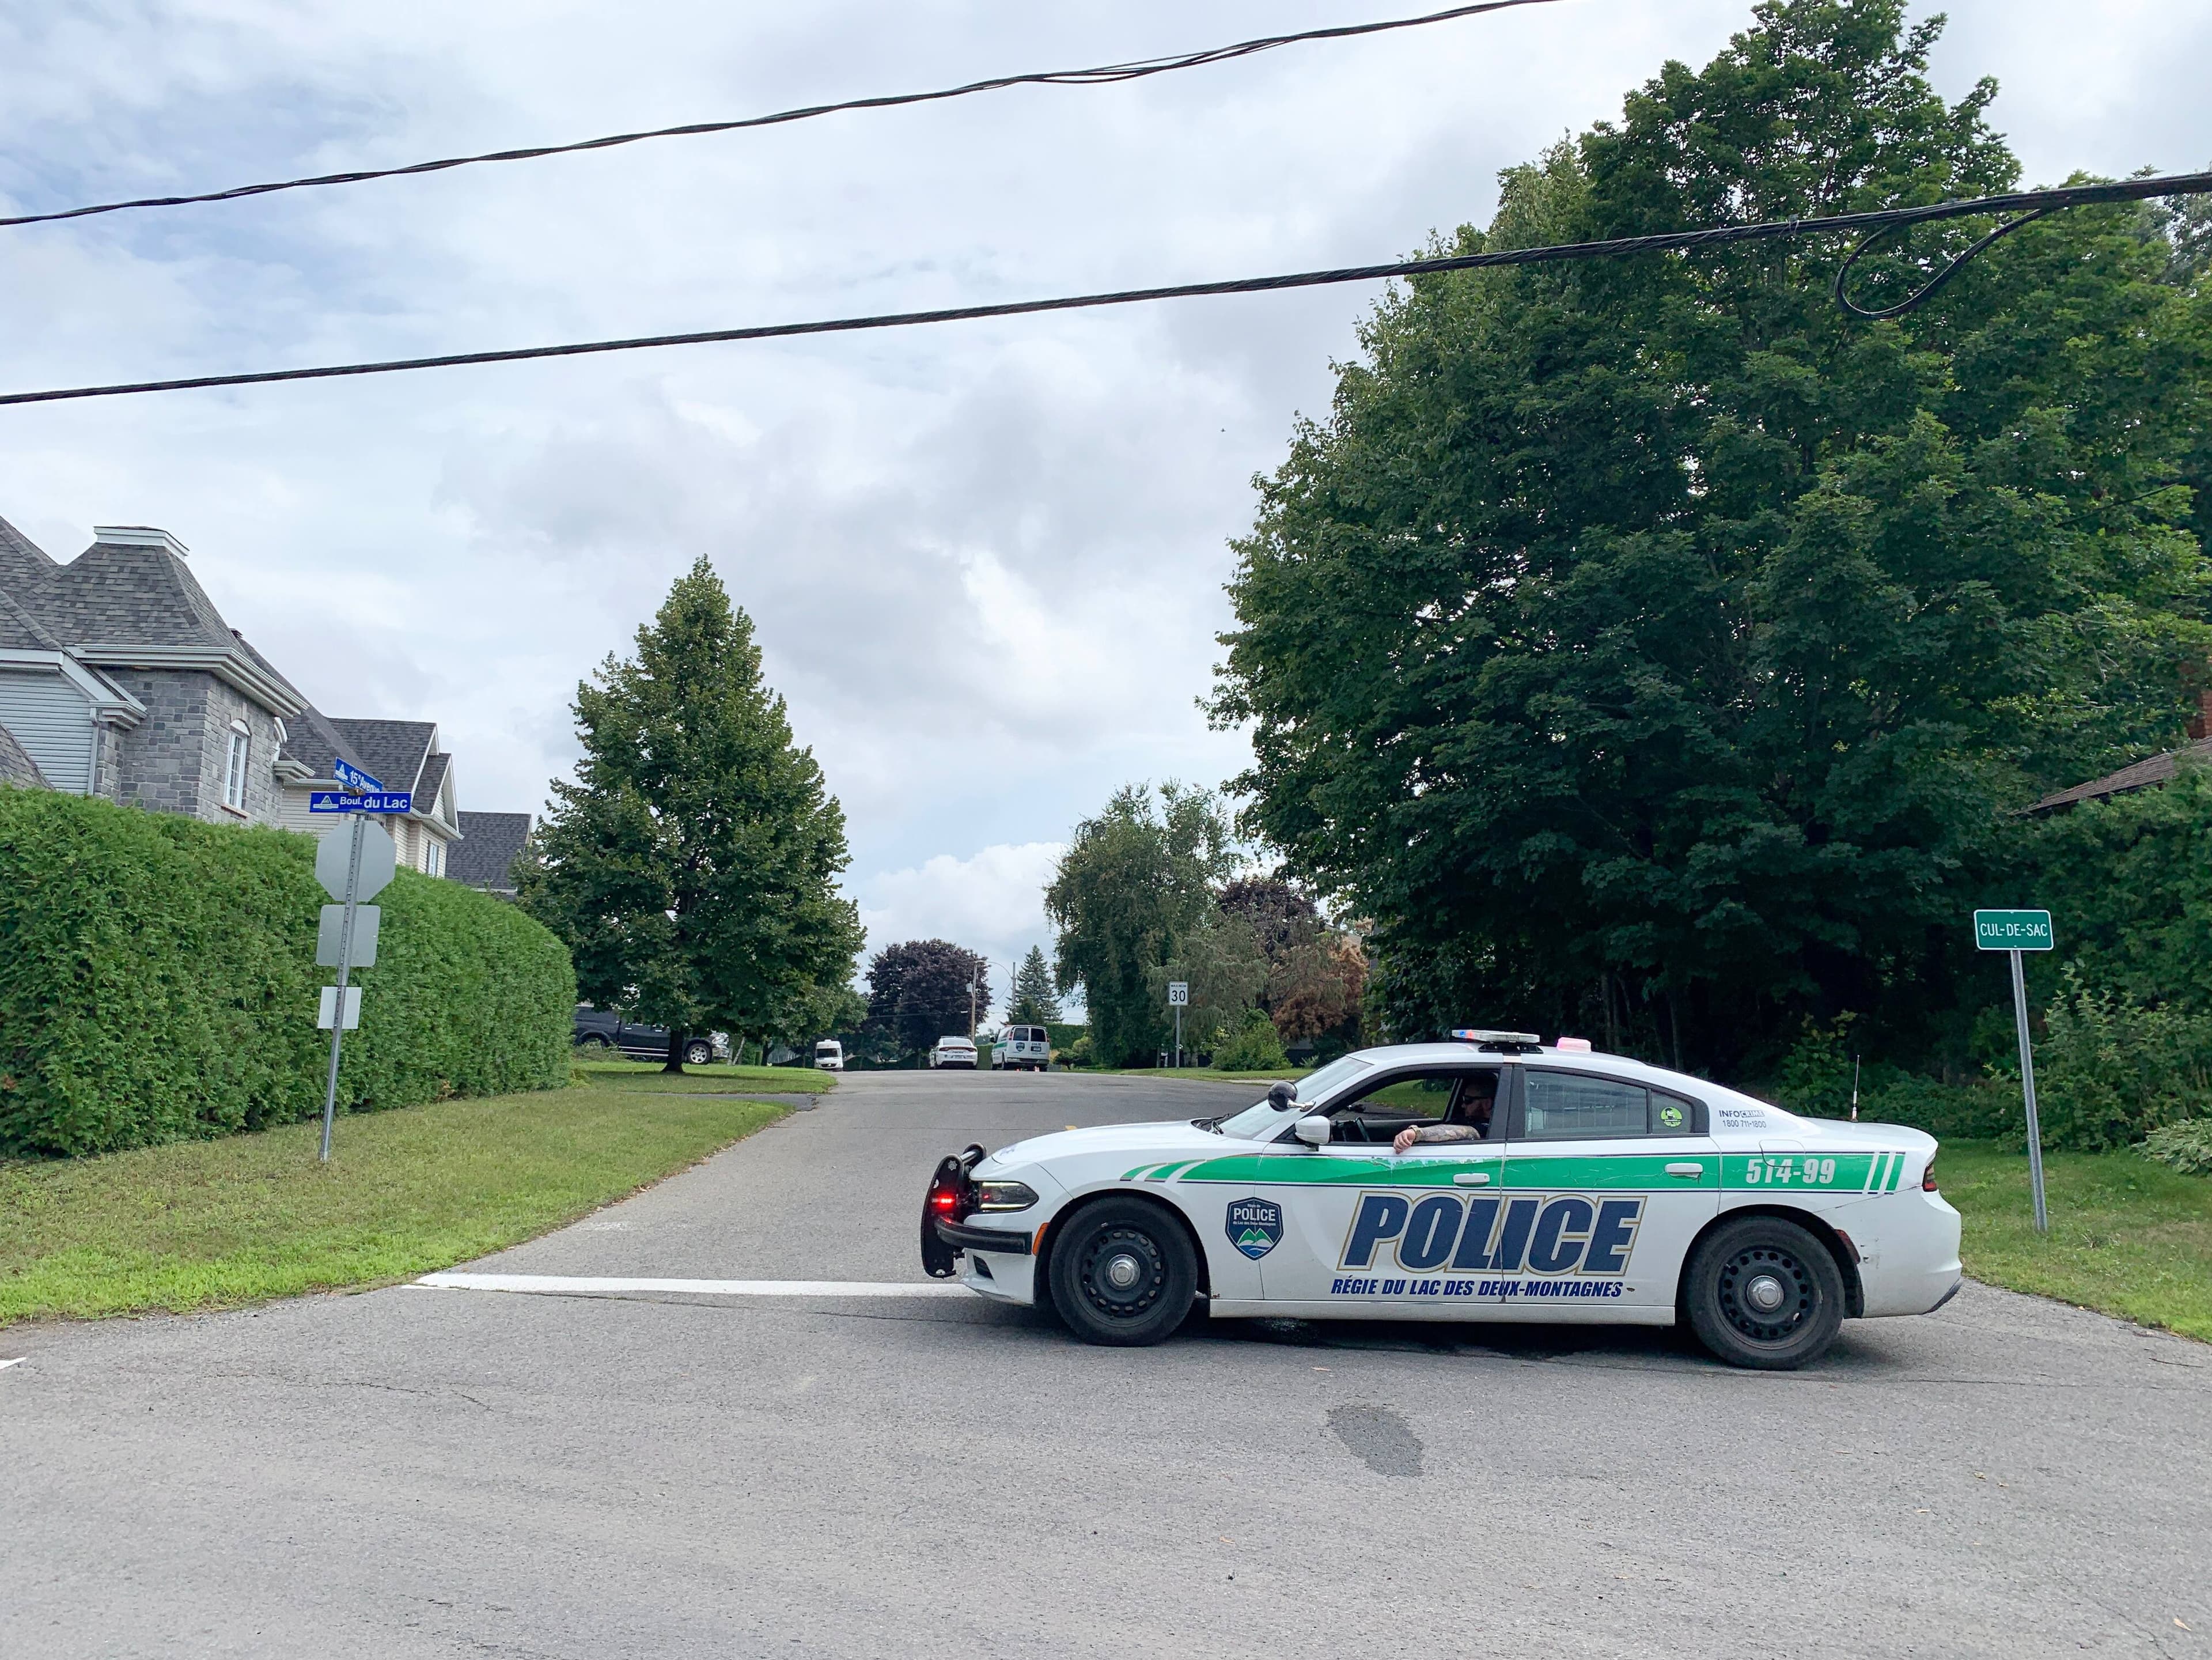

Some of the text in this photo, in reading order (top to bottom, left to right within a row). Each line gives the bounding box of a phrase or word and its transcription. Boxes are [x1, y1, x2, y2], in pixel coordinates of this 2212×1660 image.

[340, 796, 408, 808] Boul. du Lac
[1980, 923, 2048, 936] CUL-DE-SAC
[1171, 990, 1186, 1002] 30
[1745, 1158, 1836, 1184] 514-99
[1233, 1207, 1276, 1222] POLICE
[1340, 1193, 1643, 1274] POLICE
[1331, 1275, 1624, 1297] RÉGIE DU LAC DES DEUX-MONTAGNES
